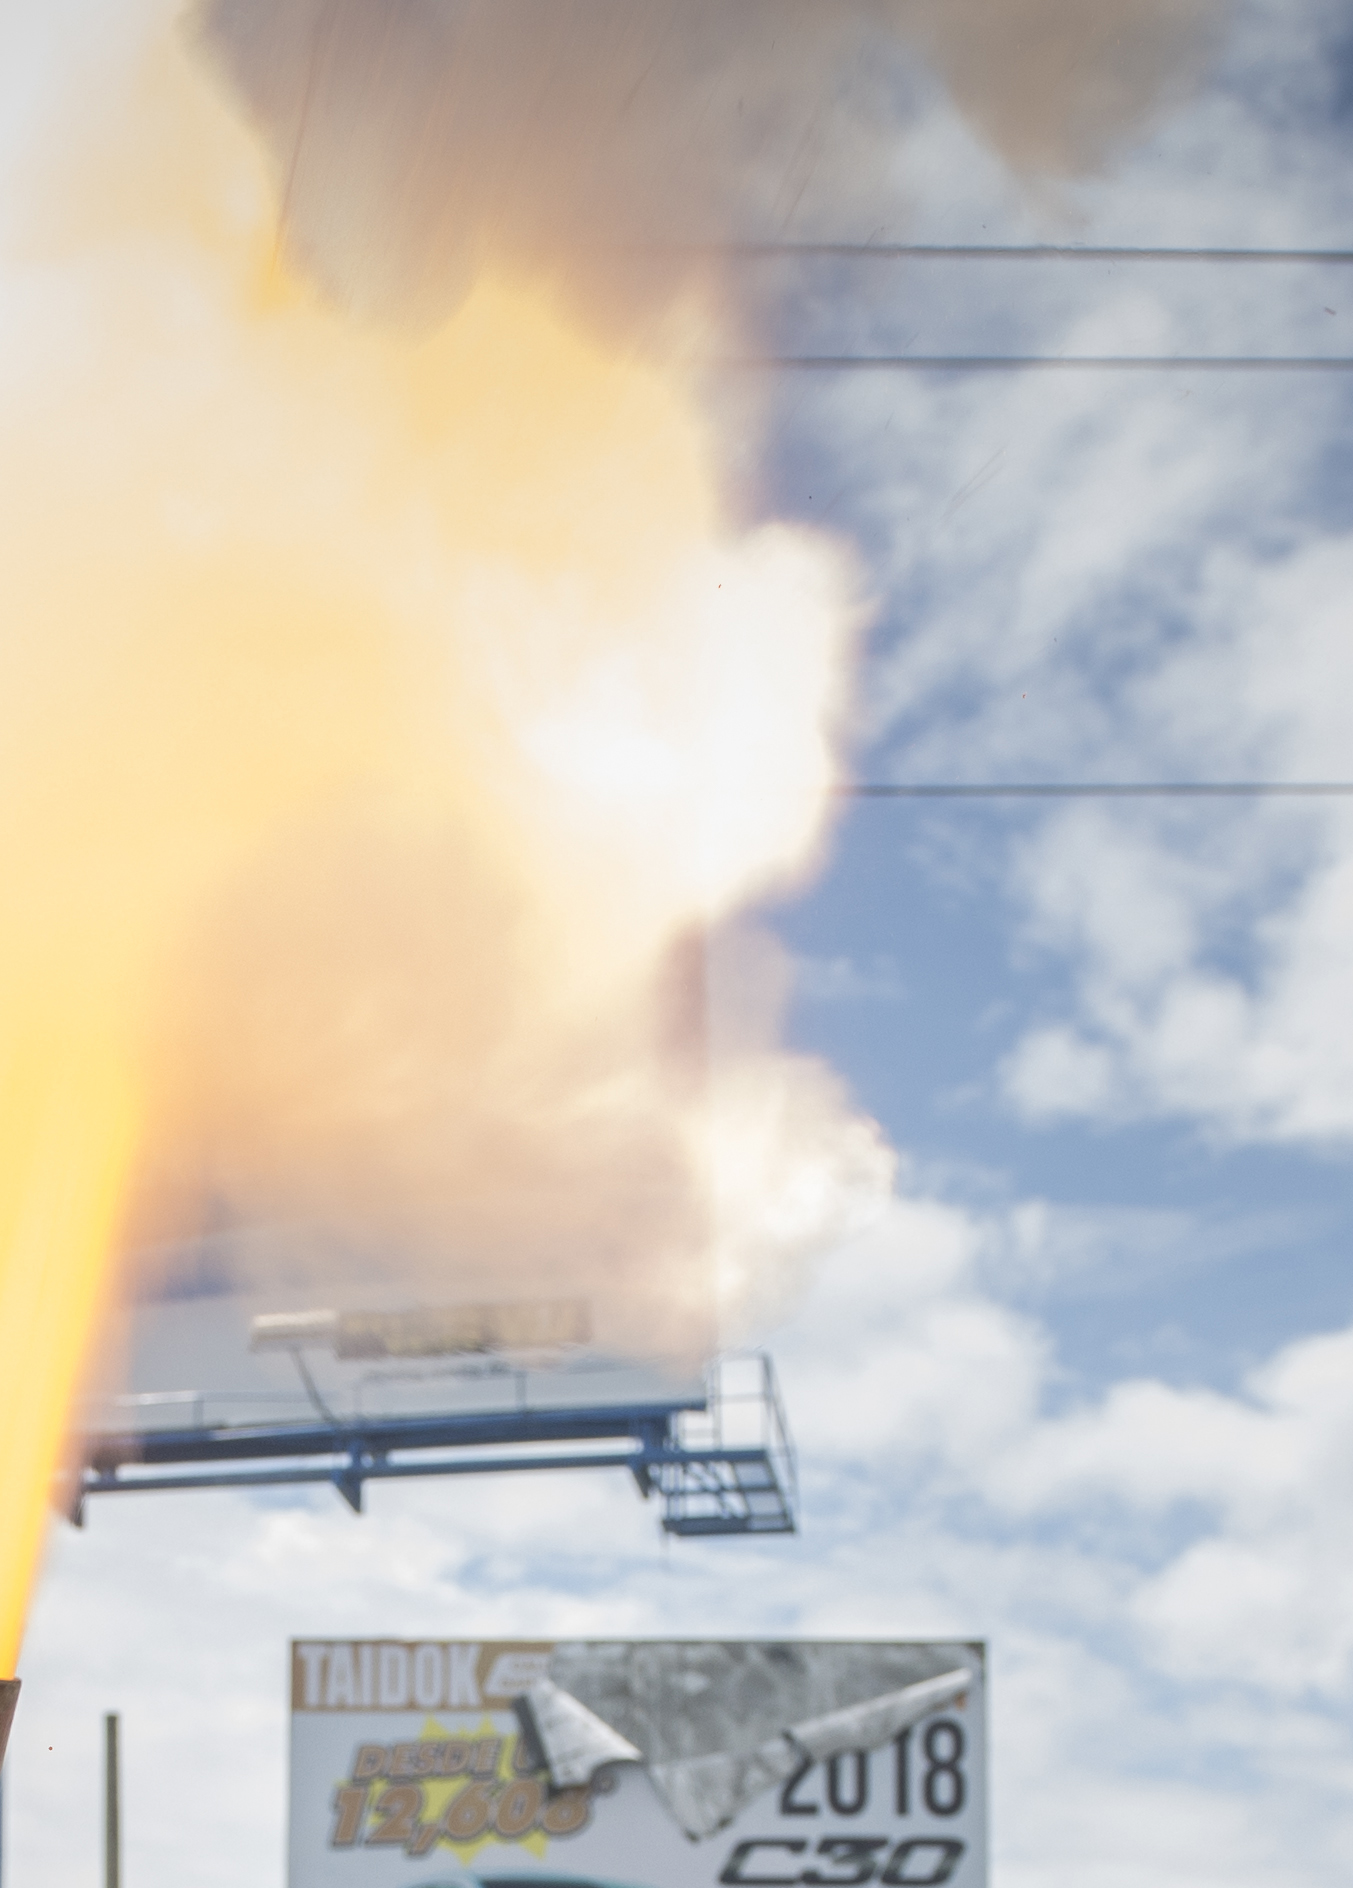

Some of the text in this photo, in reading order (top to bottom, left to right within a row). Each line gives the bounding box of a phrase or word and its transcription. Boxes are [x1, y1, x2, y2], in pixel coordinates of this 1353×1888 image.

[297, 1644, 485, 1706] TAIDOK
[354, 1738, 502, 1780] DESDE
[779, 1720, 964, 1816] 2018
[718, 1838, 965, 1887] C30
